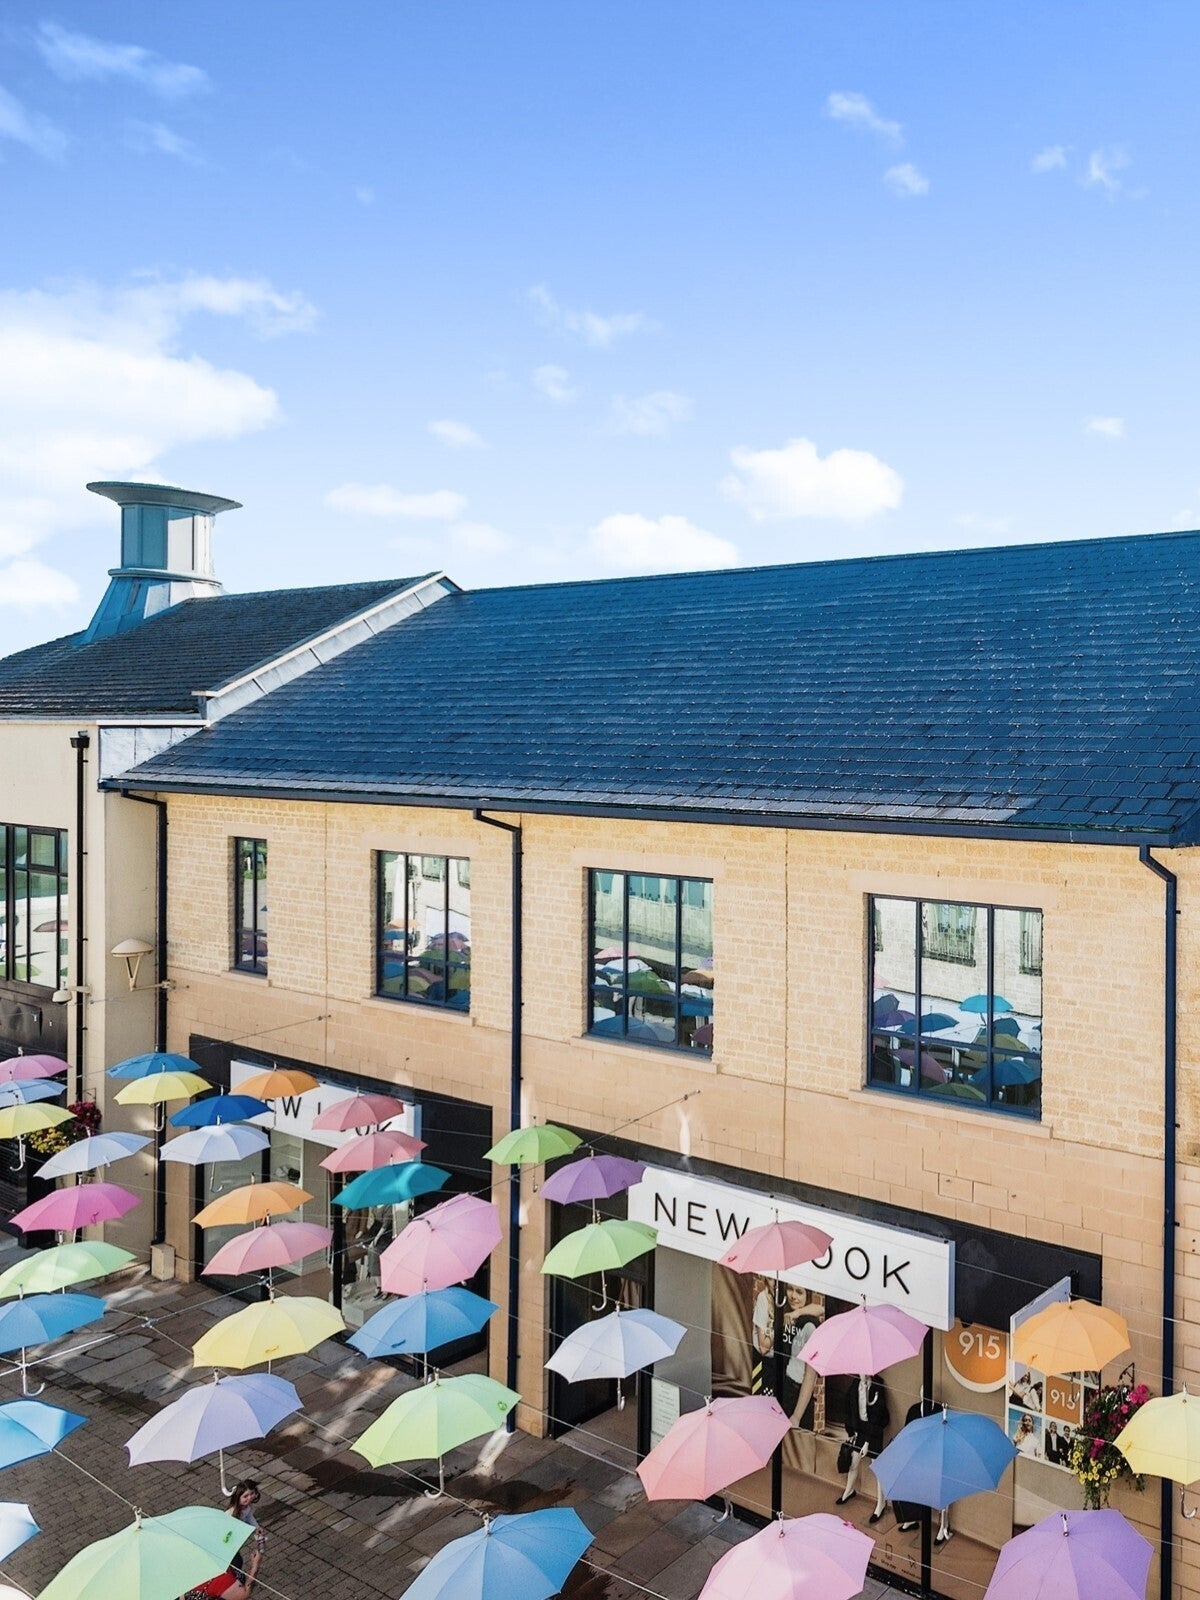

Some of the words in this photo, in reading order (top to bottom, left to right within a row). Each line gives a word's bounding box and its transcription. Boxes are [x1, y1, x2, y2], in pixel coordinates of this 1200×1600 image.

[655, 1193, 750, 1242] NEW
[810, 1245, 911, 1295] OOK
[959, 1331, 1000, 1359] 915
